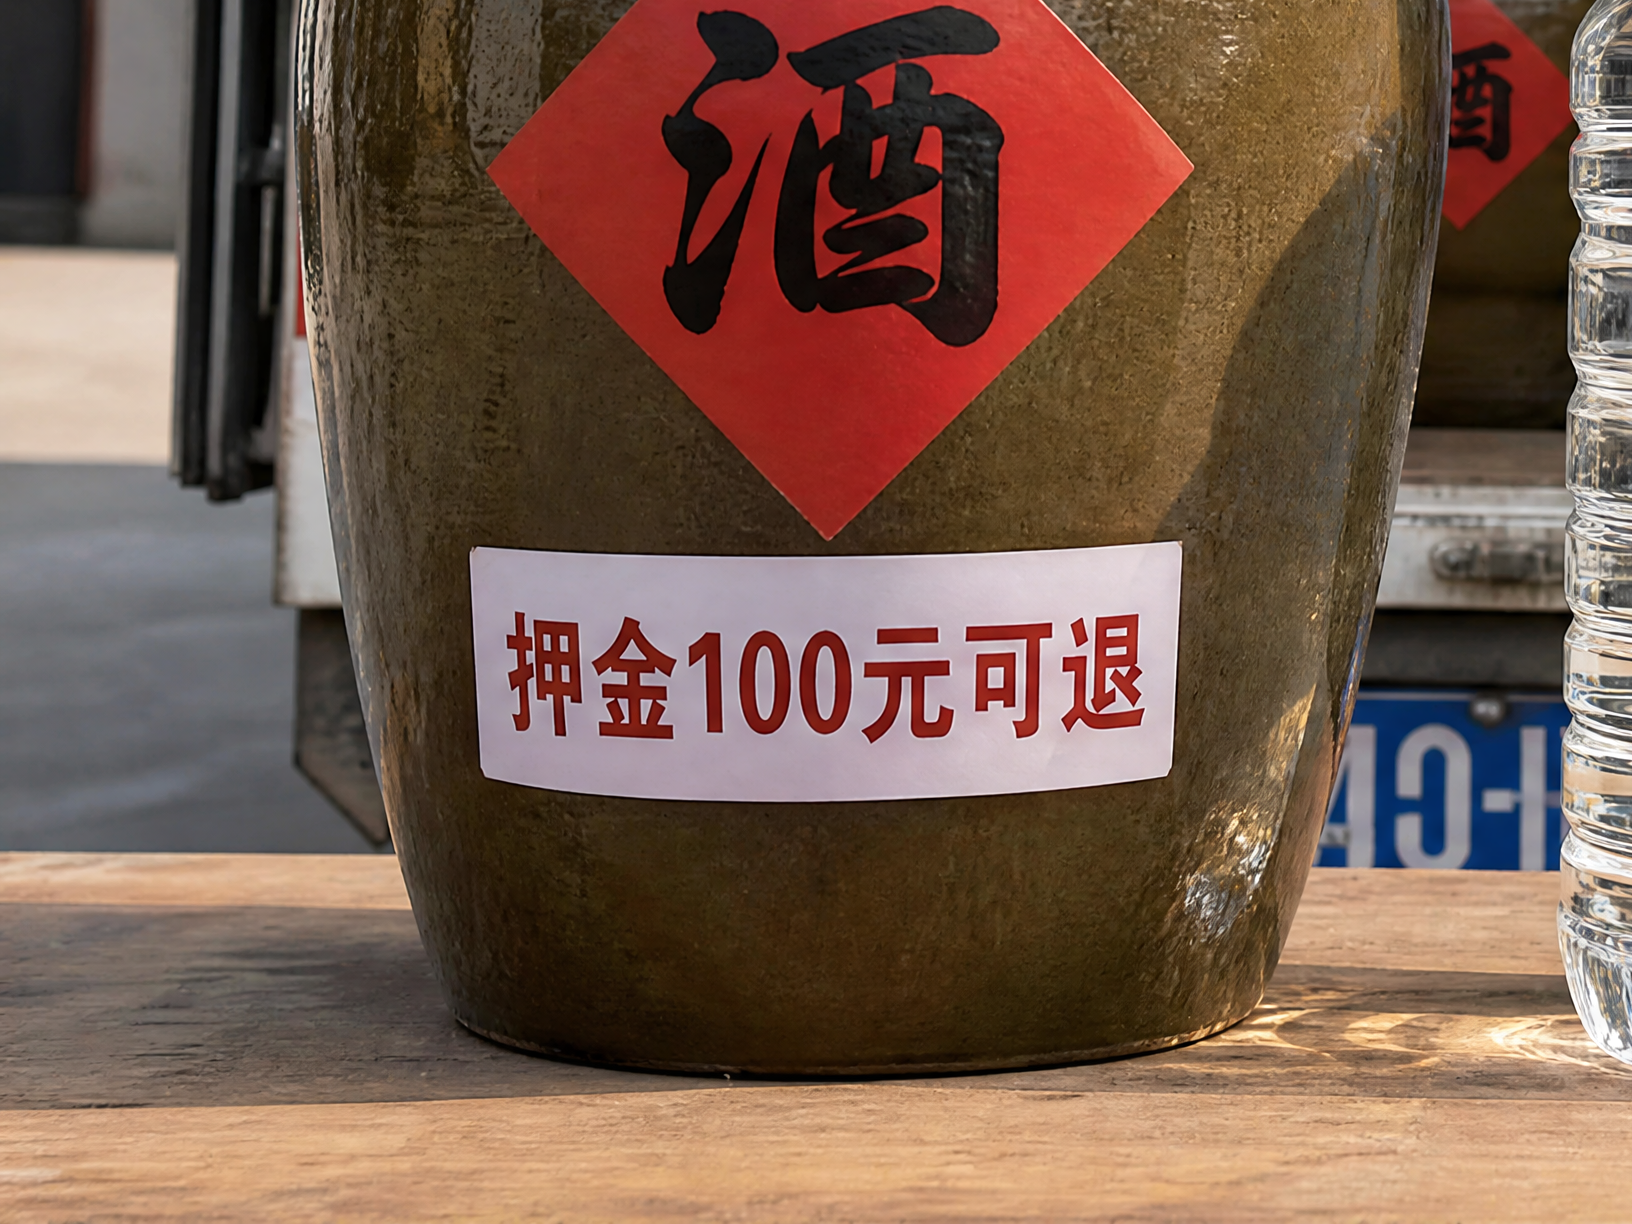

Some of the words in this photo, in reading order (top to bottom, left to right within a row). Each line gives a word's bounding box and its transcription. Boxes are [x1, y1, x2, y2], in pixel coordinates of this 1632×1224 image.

[662, 6, 1004, 346] 酒
[508, 612, 1144, 743] 押金100元可退
